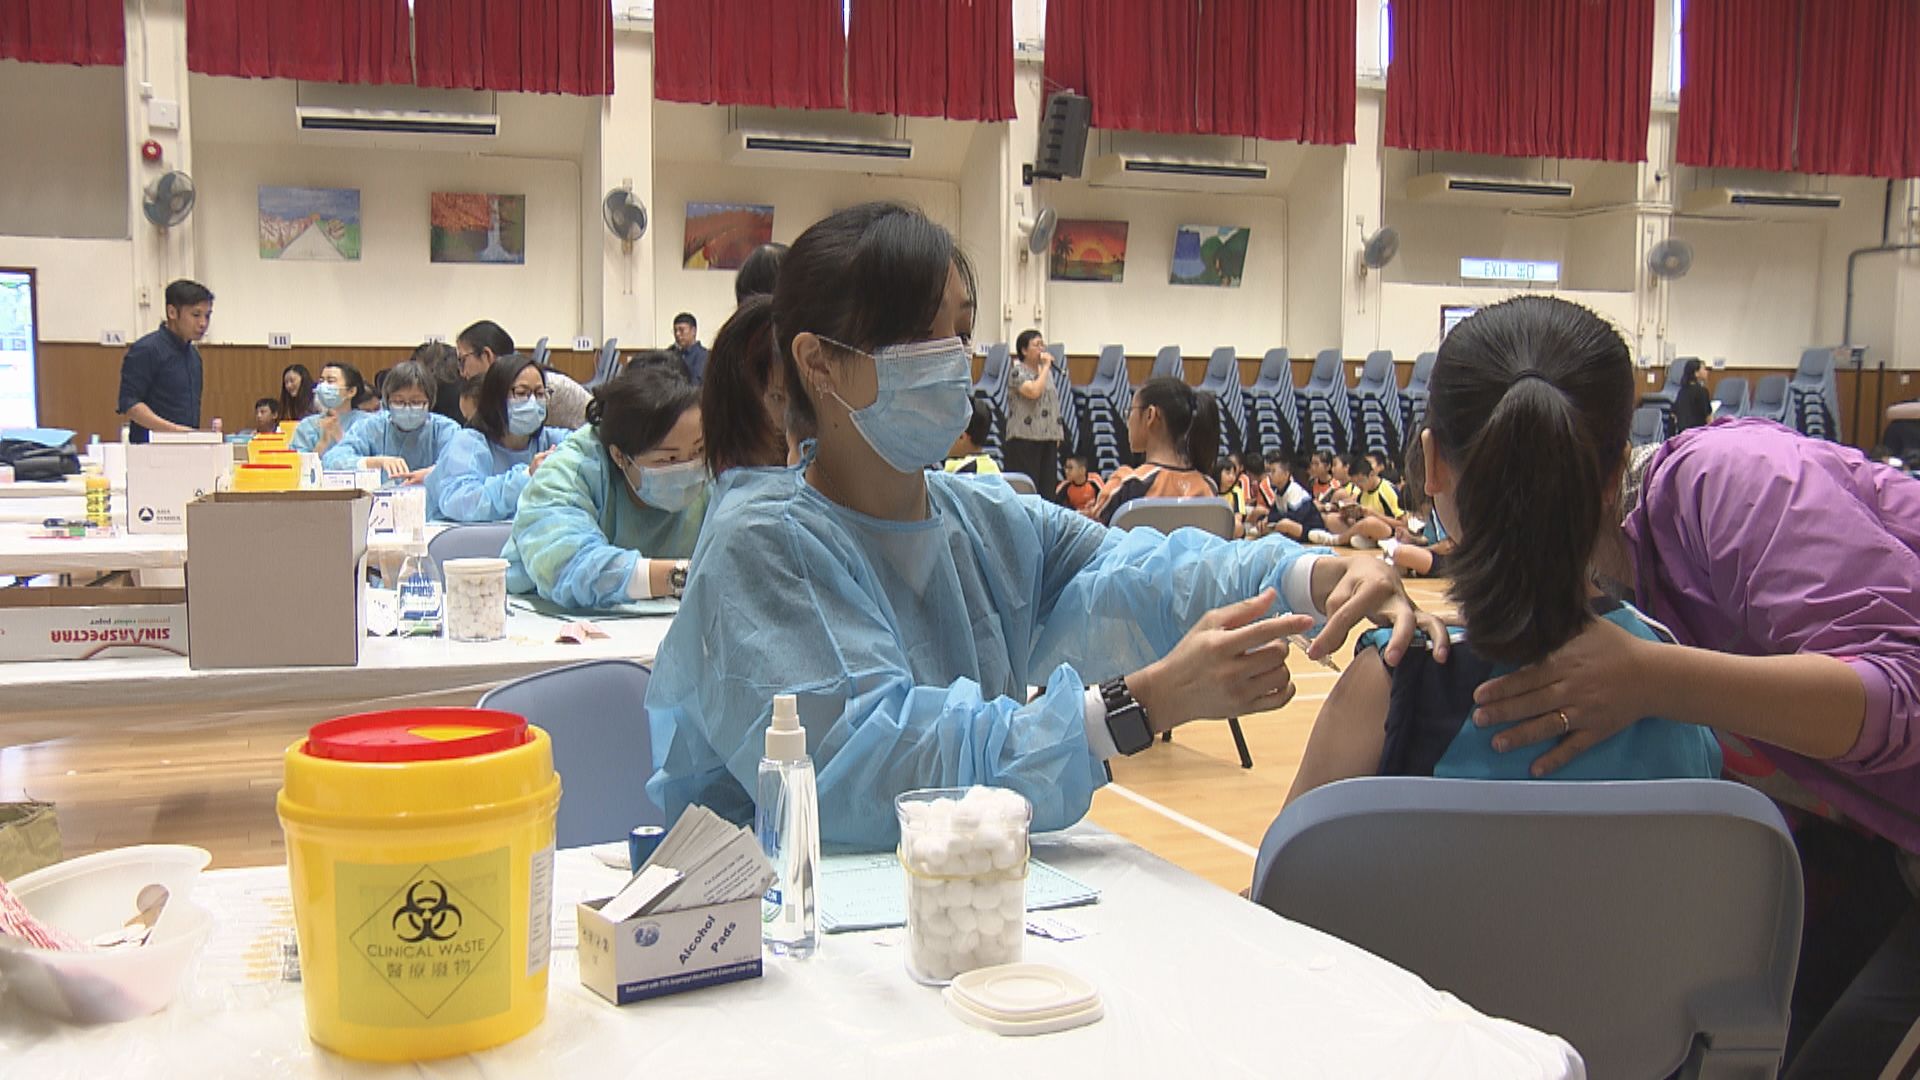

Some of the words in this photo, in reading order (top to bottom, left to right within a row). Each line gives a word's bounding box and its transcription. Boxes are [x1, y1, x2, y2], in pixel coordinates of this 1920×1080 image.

[1484, 261, 1508, 277] EXIT
[1517, 263, 1535, 279] 出口
[273, 335, 287, 345] 1B
[577, 339, 590, 348] 1D
[679, 914, 715, 964] Alcohol
[711, 921, 736, 953] Pads
[366, 943, 434, 958] CLINICAL
[438, 938, 485, 955] WASTE
